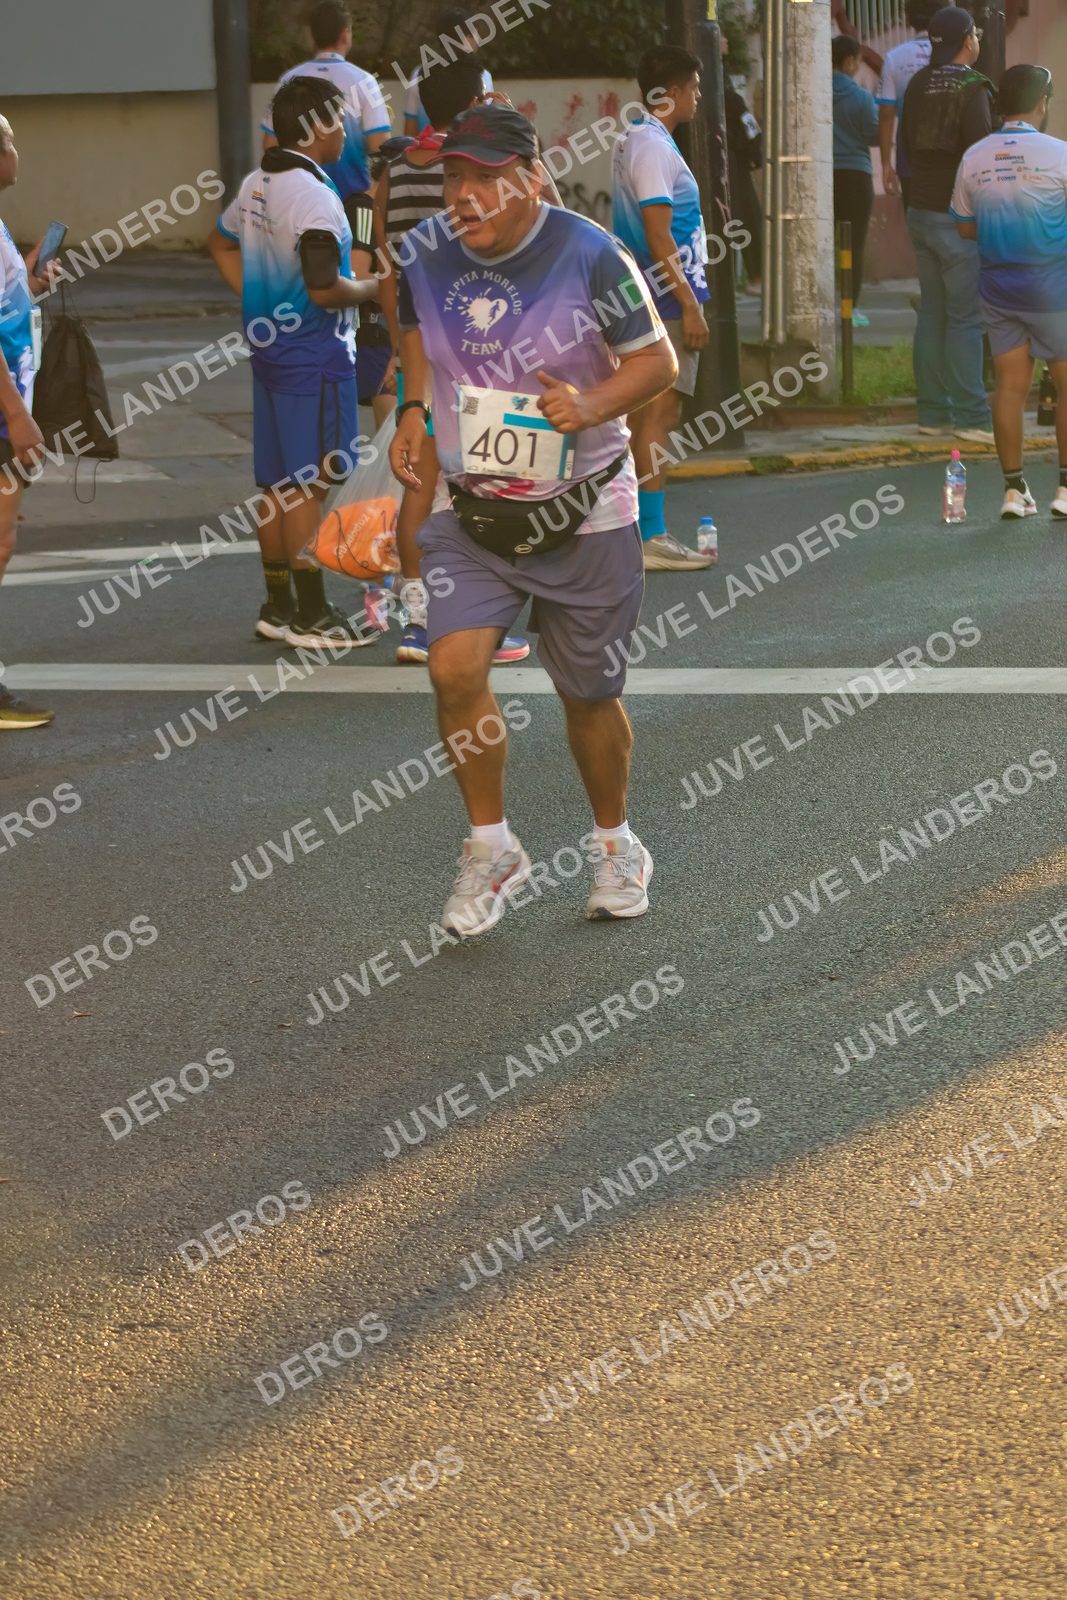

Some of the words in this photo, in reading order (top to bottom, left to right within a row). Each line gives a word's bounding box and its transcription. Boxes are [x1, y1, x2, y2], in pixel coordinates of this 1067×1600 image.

[444, 271, 479, 312] TALPITA
[483, 270, 522, 315] MORELOS
[460, 338, 503, 355] TEAM
[467, 426, 538, 468] 401
